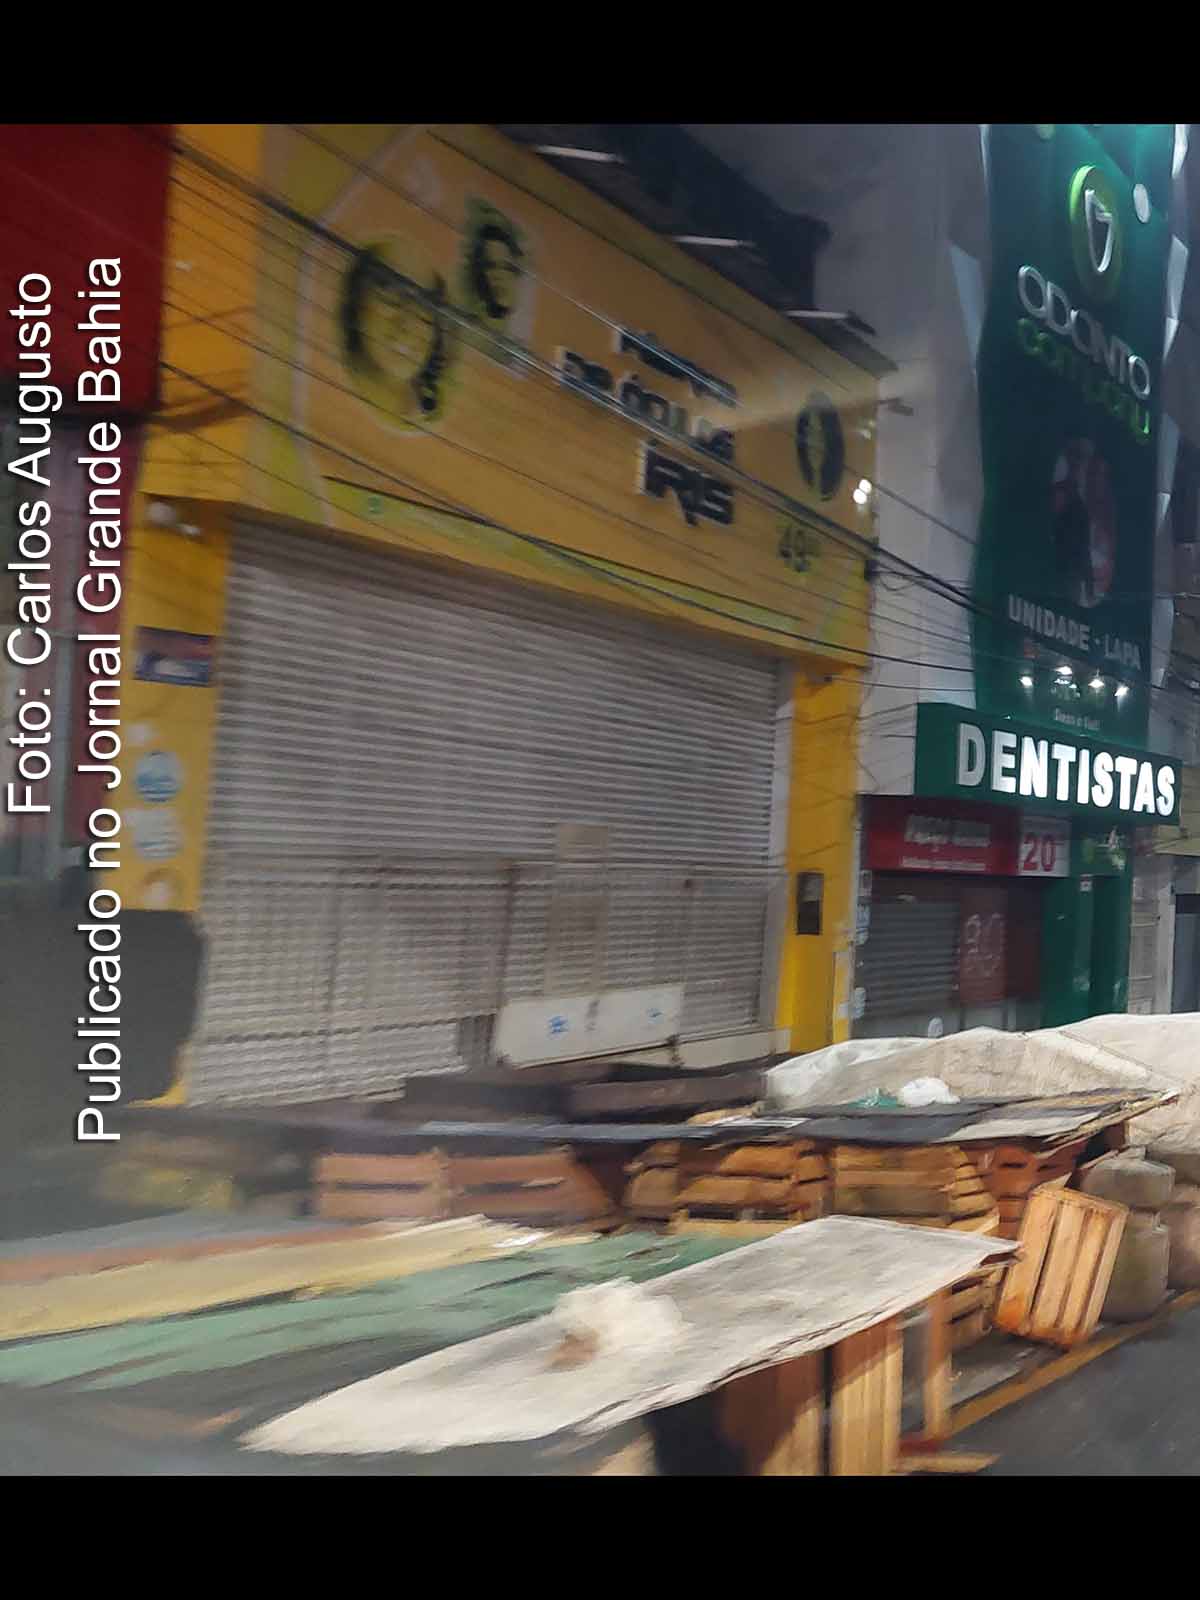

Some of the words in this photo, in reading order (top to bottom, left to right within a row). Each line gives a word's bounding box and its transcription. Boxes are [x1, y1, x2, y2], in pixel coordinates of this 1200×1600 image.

[1008, 593, 1091, 651] UNIDADE
[957, 721, 1176, 817] DENTISTAS
[1023, 831, 1056, 872] 20
